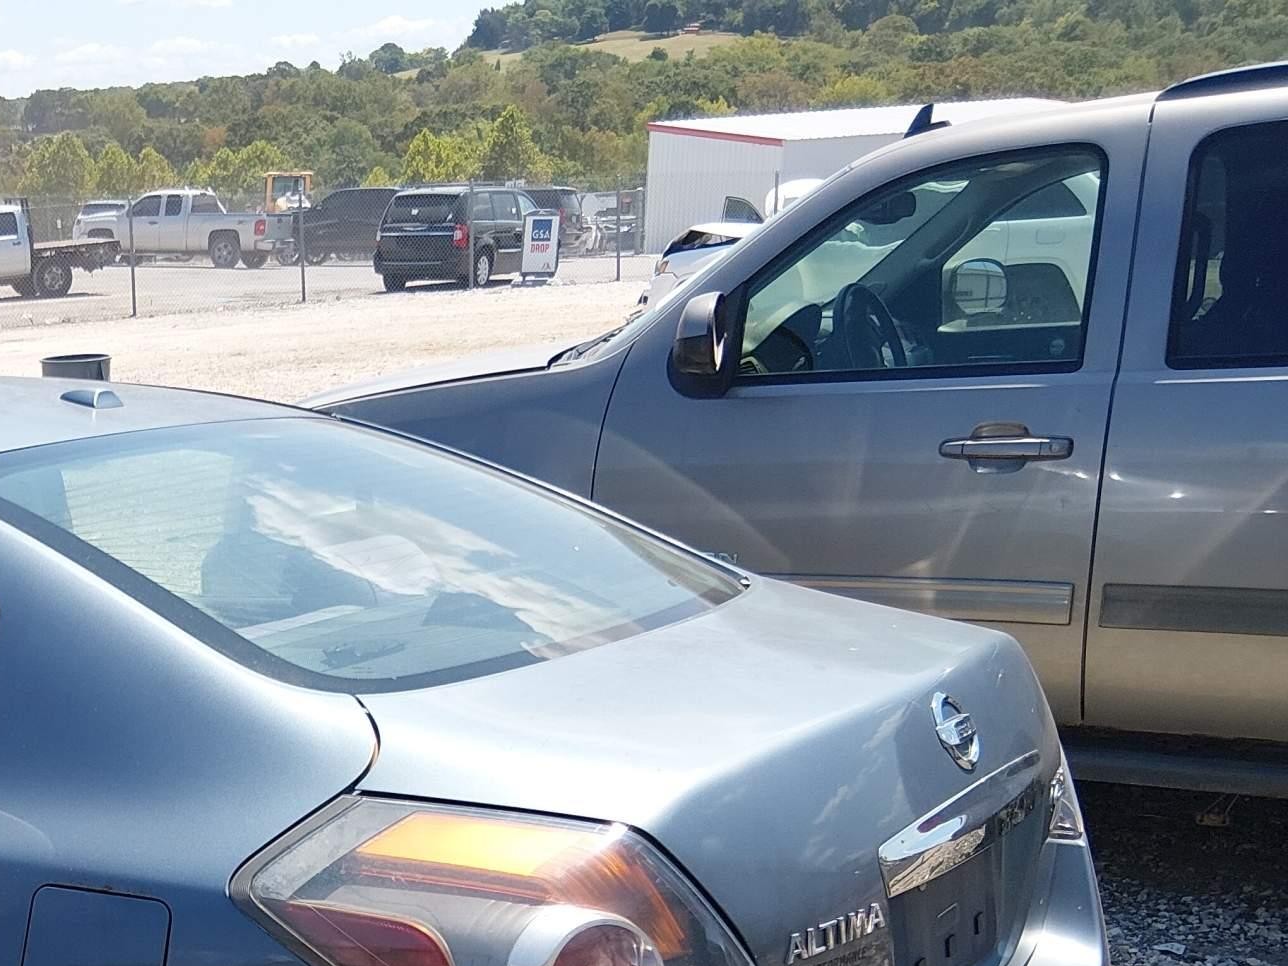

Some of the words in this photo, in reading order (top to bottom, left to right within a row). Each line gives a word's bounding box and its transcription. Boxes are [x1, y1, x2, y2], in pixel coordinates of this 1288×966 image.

[532, 229, 551, 240] GSA
[530, 243, 550, 254] DROP
[787, 902, 886, 966] ALTIMA
